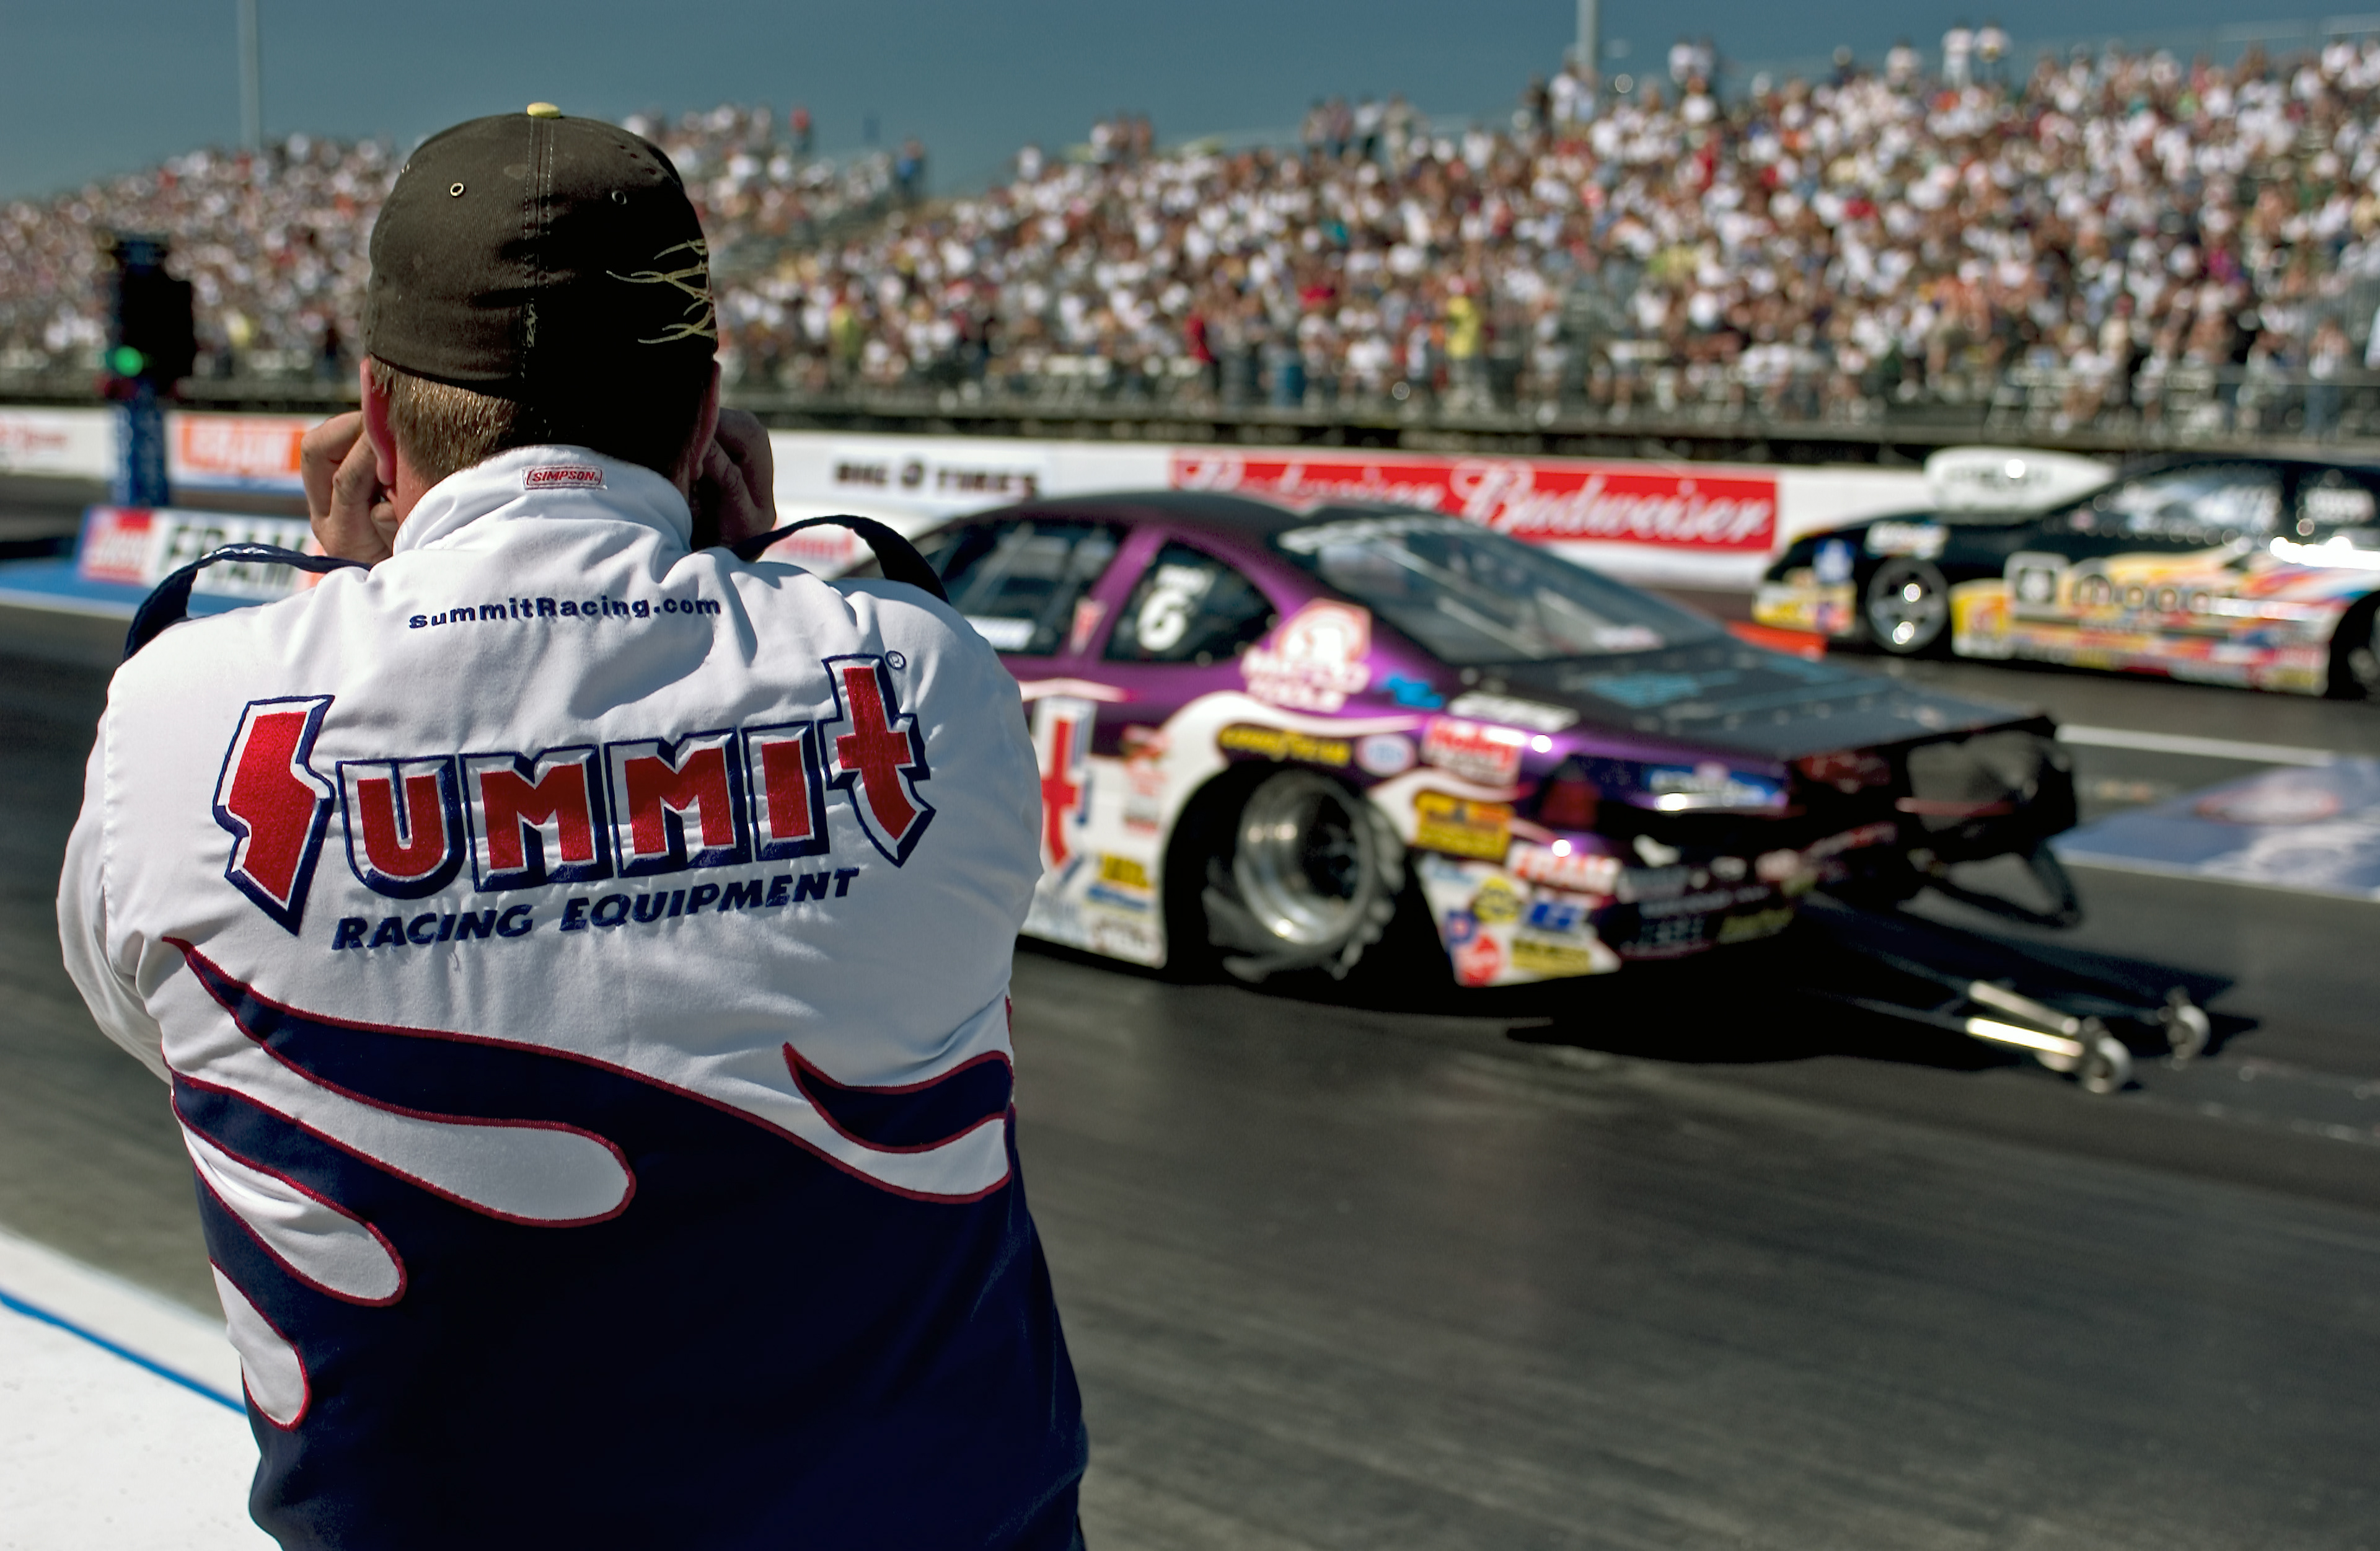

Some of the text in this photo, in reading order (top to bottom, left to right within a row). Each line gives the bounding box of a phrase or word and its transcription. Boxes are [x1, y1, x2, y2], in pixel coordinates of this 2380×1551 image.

[532, 471, 596, 482] SIMPSON
[1450, 460, 1773, 542] Budweiser
[408, 595, 721, 629] summitRacing.com
[1135, 588, 1188, 652] 6
[332, 867, 860, 951] RACING EQUIPMENT
